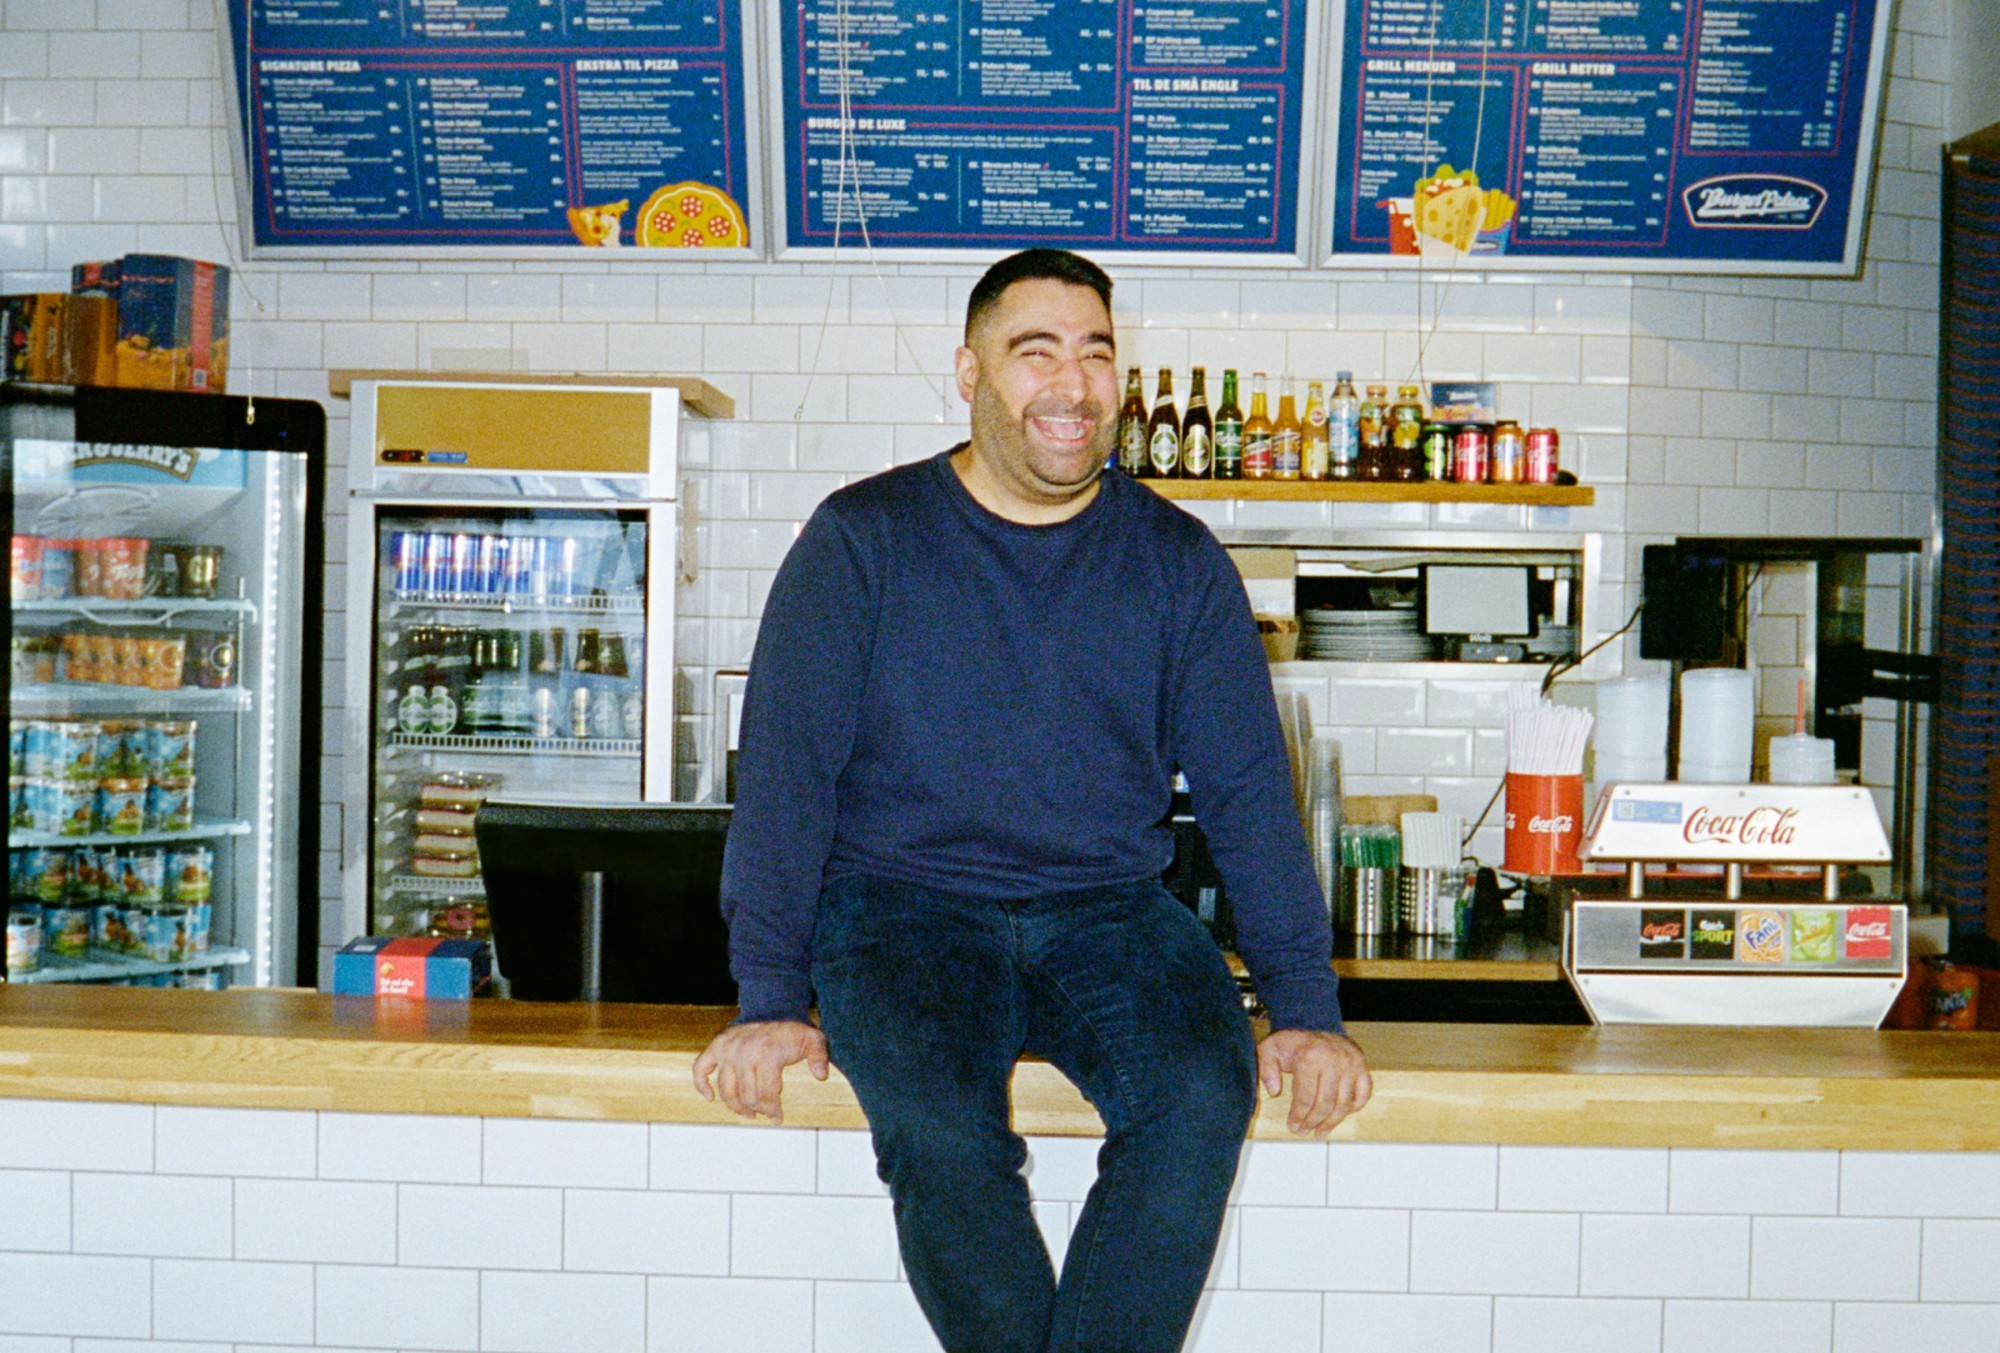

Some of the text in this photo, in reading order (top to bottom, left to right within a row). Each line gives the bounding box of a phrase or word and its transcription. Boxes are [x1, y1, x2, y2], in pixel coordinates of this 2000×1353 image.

[260, 60, 361, 72] SIGNATURE PIZZA
[576, 60, 678, 71] EKSTRA TIL PIZZA
[1367, 60, 1456, 73] GRILL MENUER
[1532, 62, 1616, 76] GRILL RETTER
[1134, 76, 1238, 92] TIL DE SMÅ ENGLE
[808, 118, 906, 130] BURGER DE LUXE
[1697, 187, 1763, 216] Burger
[1528, 816, 1572, 833] Coca-Cola
[1682, 806, 1800, 844] Coca-Cola
[1642, 922, 1681, 938] Coca-Cola
[1848, 922, 1888, 937] Coca-Cola
[1692, 930, 1734, 945] SPORT
